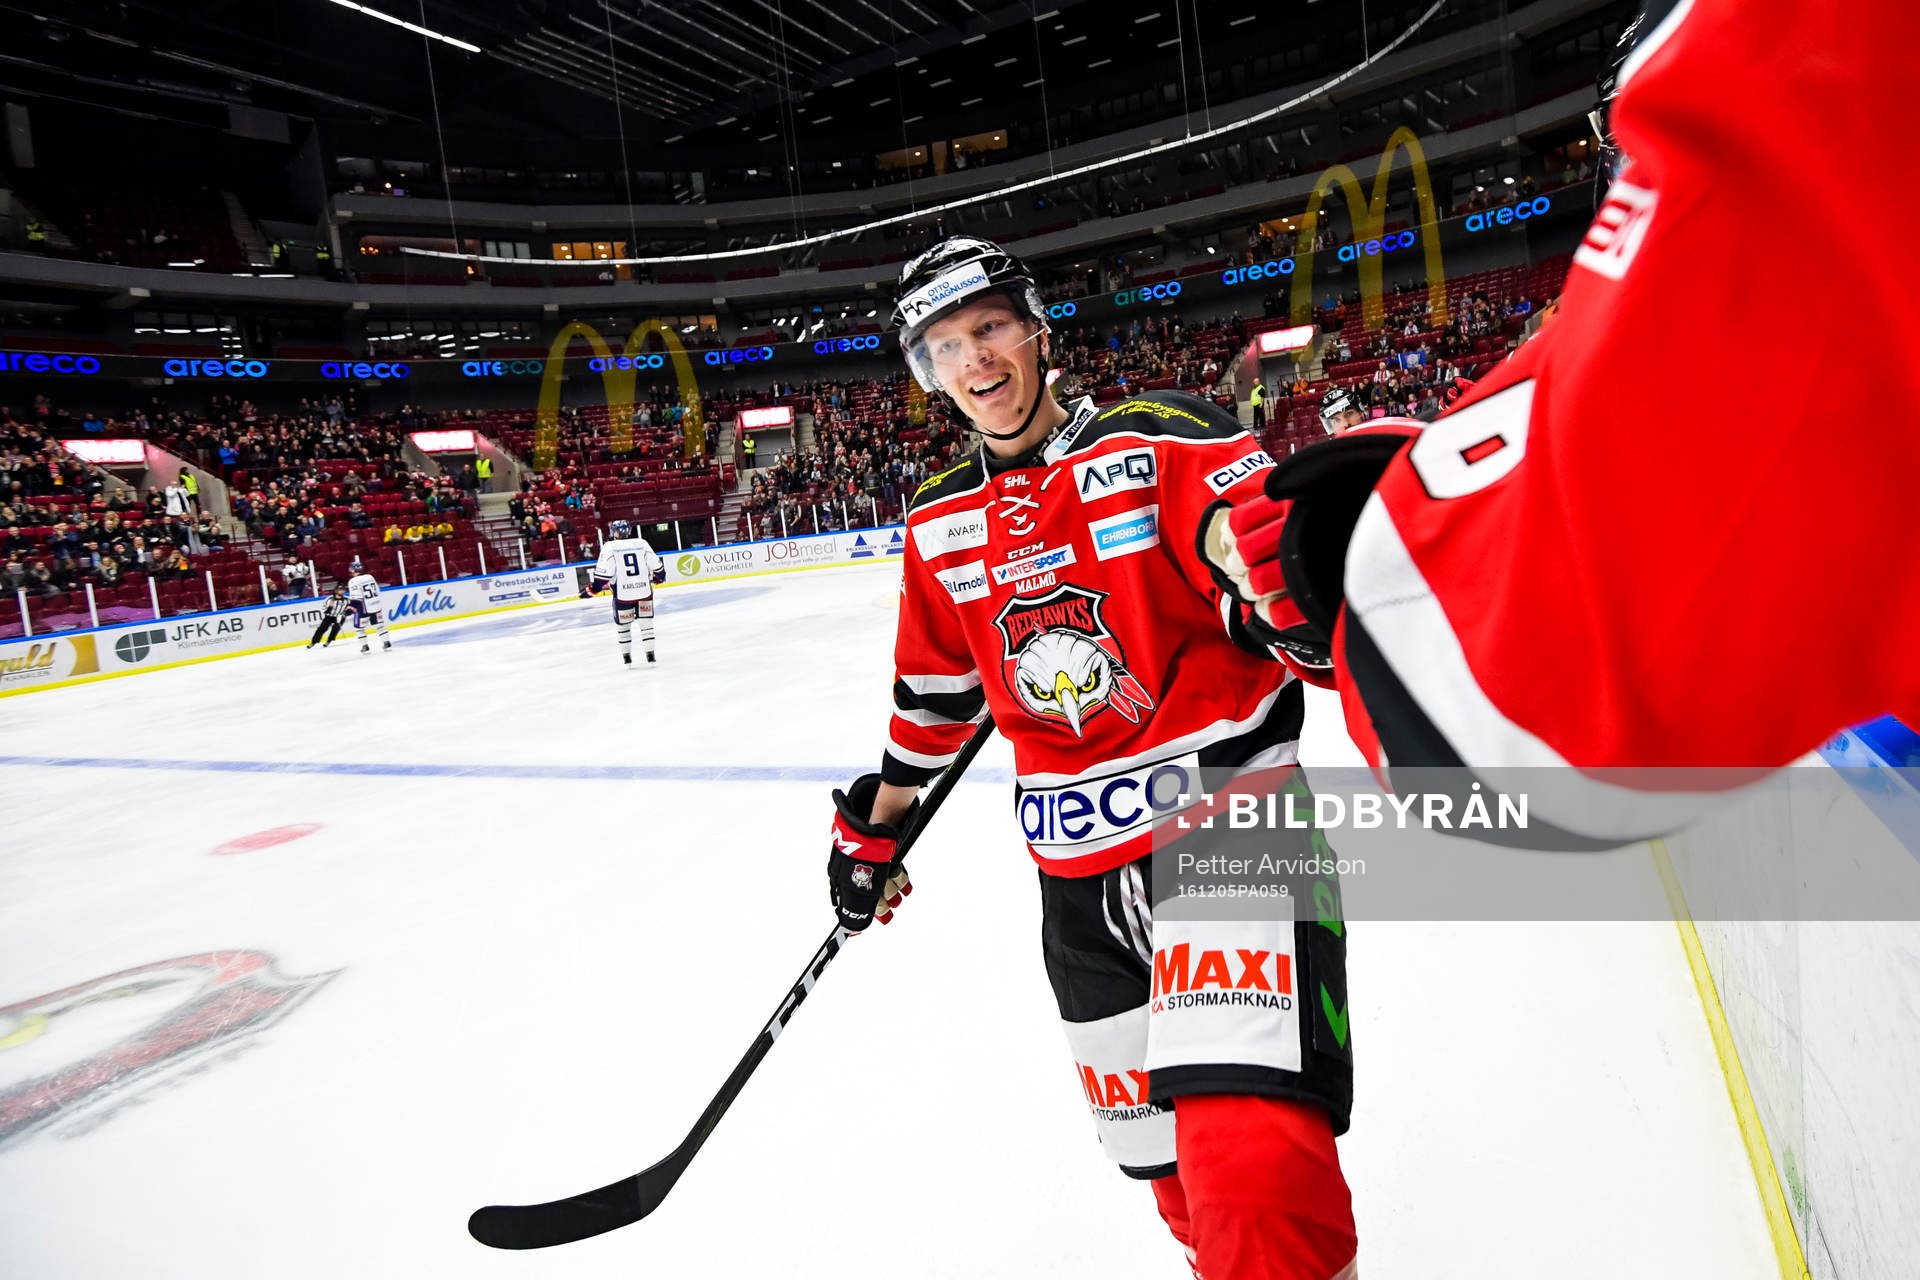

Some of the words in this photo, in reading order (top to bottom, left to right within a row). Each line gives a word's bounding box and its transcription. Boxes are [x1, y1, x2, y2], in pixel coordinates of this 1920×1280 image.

[1465, 196, 1551, 232] areco
[1338, 231, 1415, 262] areco
[1222, 258, 1295, 285] areco
[928, 281, 950, 297] OTTO
[931, 274, 986, 304] MAGNUSSON
[1114, 280, 1182, 306] areco
[813, 333, 880, 355] areco
[588, 353, 664, 373] areco
[704, 346, 773, 366] areco
[164, 358, 267, 378] areco
[320, 360, 410, 379] areco
[462, 358, 543, 378] areco
[1004, 474, 1031, 489] SHL
[1213, 454, 1274, 487] CLIM
[704, 550, 752, 564] VOLITO
[764, 536, 837, 562] JOBmeal
[1007, 541, 1044, 559] CCM
[623, 553, 640, 576] 9
[1007, 550, 1067, 577] INTERSPORT
[552, 572, 565, 581] AB
[1016, 571, 1056, 594] MALMÖ
[172, 622, 211, 641] JFK
[217, 618, 244, 634] AB
[1005, 597, 1094, 650] REDHAWKS
[178, 634, 242, 649] Klimatservice
[1020, 764, 1190, 841] areco
[1152, 942, 1292, 999] MAXI
[1168, 992, 1292, 1011] STORMARKNAD
[1075, 1060, 1149, 1108] MAX
